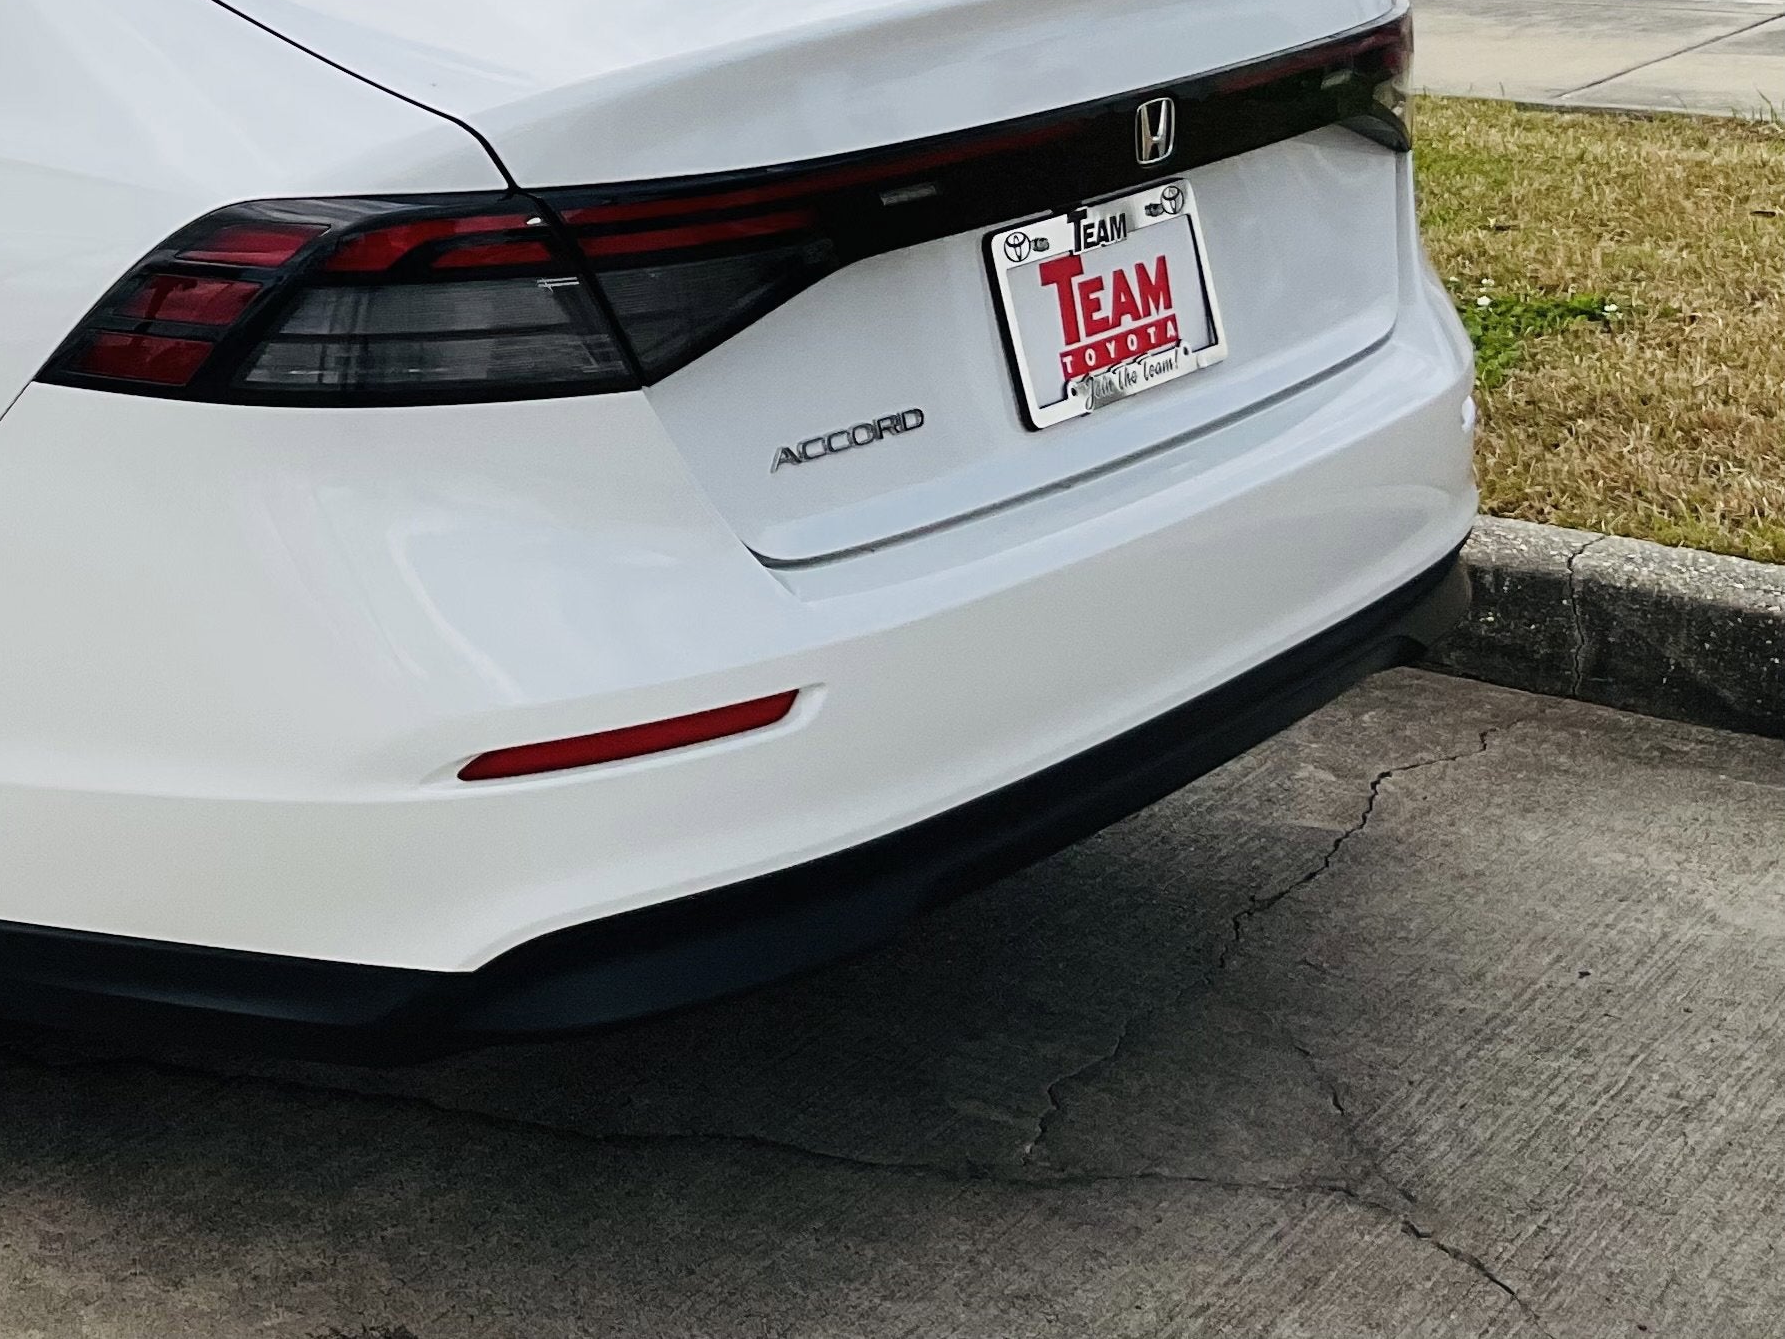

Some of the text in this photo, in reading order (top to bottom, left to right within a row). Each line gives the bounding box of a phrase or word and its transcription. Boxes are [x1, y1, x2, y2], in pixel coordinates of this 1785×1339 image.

[1066, 208, 1127, 252] TEAM
[1038, 254, 1173, 346] TEAM
[1062, 319, 1178, 374] TOYOTA
[770, 408, 925, 473] ACCORD
